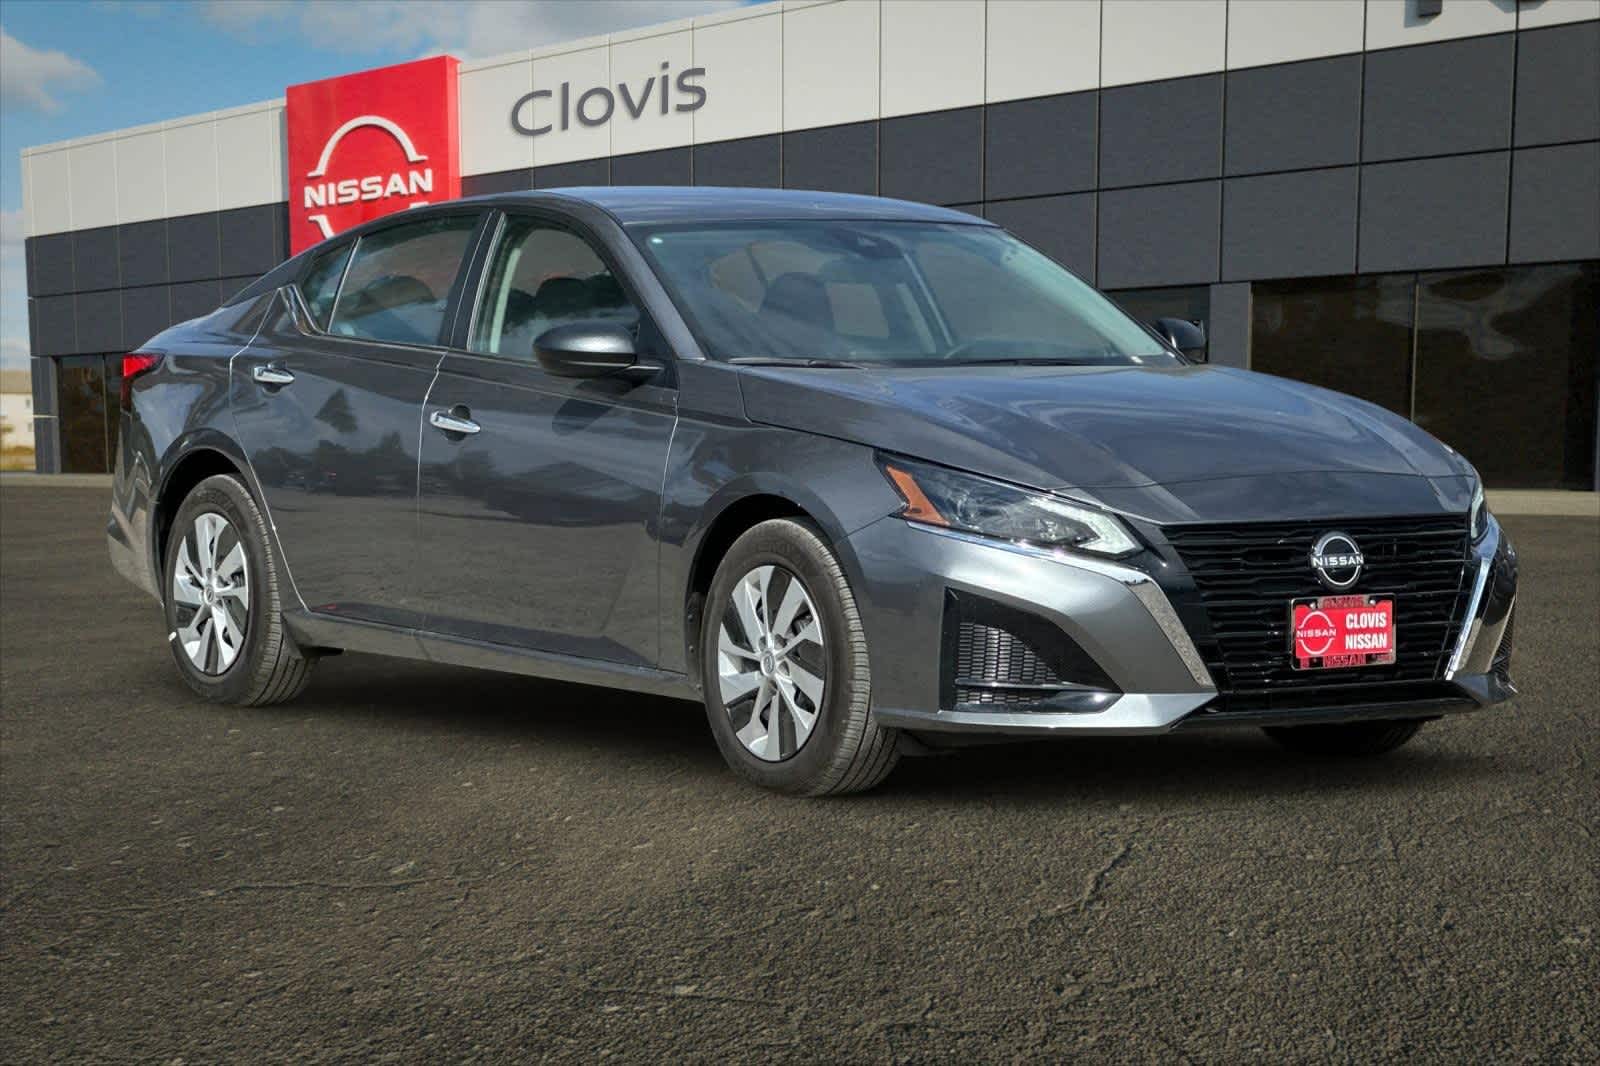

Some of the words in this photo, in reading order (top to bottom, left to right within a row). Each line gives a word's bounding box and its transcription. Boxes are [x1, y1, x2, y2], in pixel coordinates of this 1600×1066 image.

[511, 62, 708, 137] Clovis
[304, 169, 433, 208] NISSAN
[1312, 555, 1364, 567] NISSAN
[1346, 612, 1387, 629] CLOVIS
[1296, 628, 1336, 638] NISSAN
[1345, 633, 1387, 649] NISSAN
